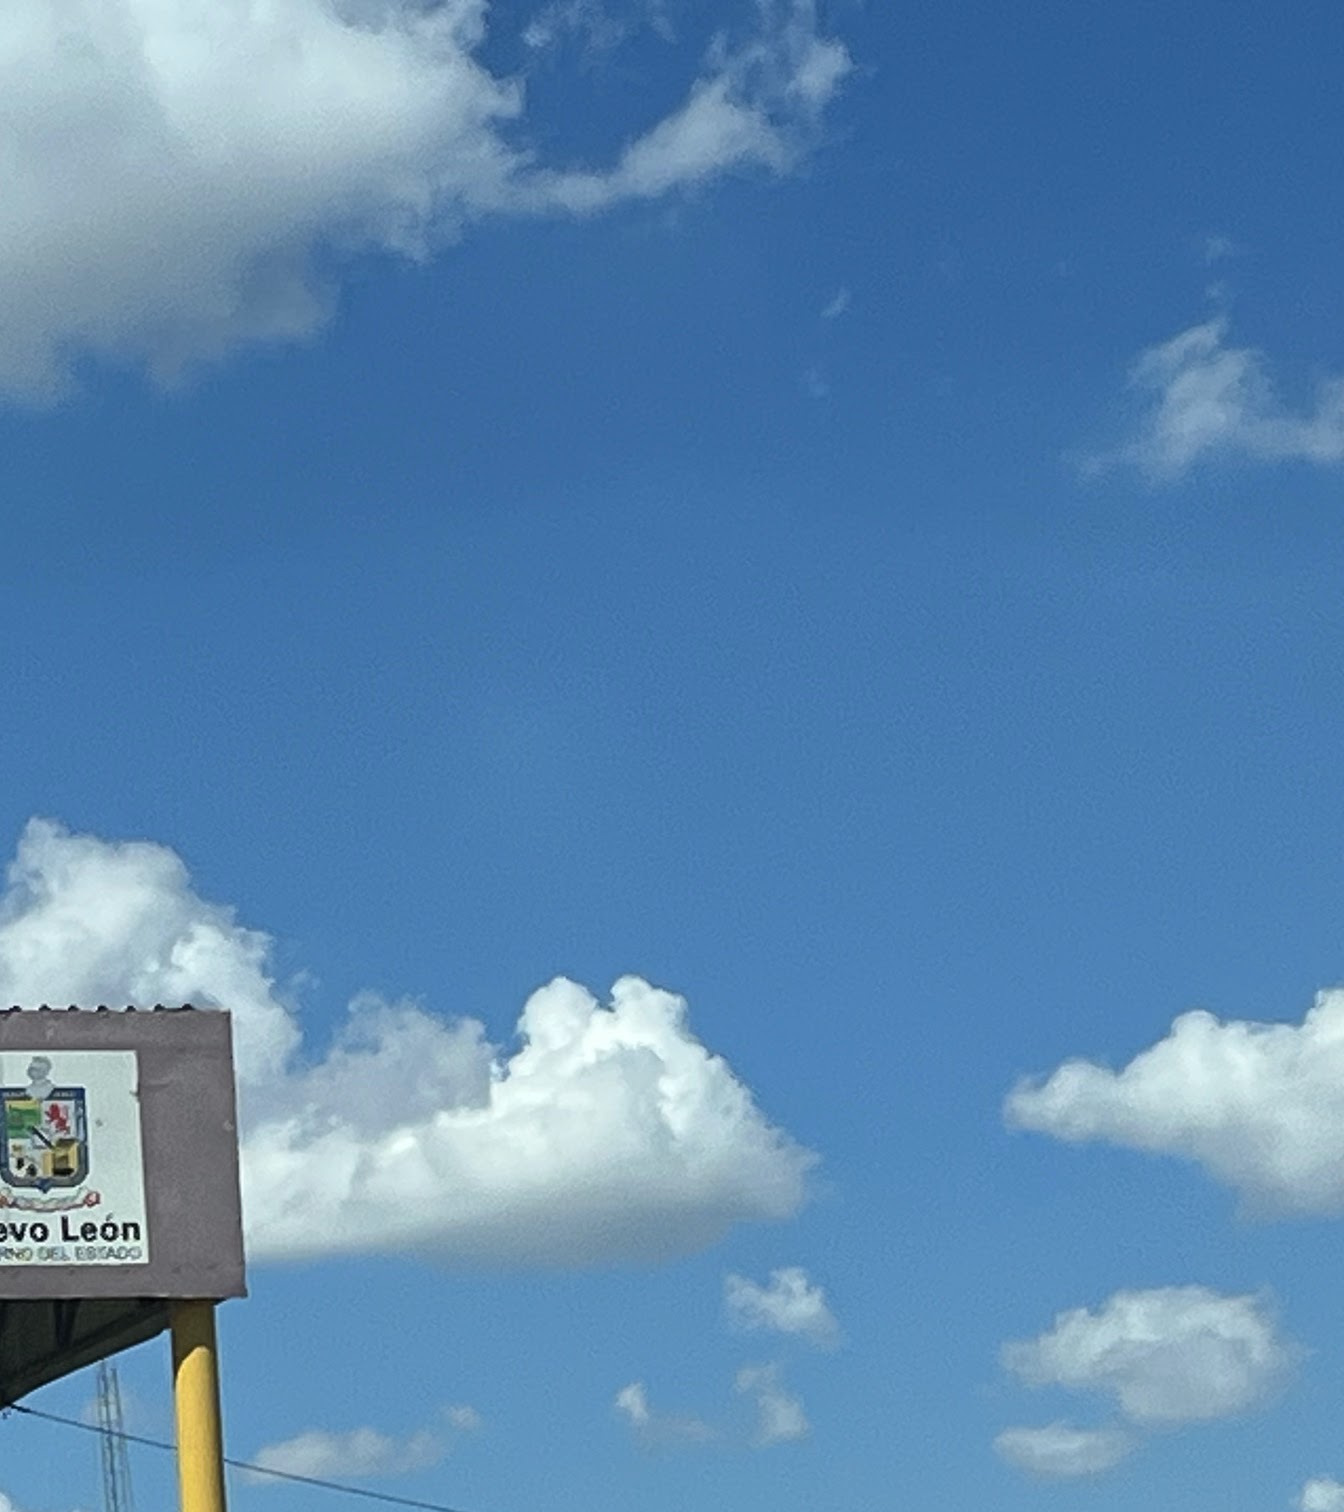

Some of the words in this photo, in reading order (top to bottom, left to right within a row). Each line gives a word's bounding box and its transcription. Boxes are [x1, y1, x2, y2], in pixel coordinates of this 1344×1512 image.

[61, 1212, 142, 1242] León
[37, 1247, 71, 1262] DEL
[75, 1246, 142, 1261] ESTADO
